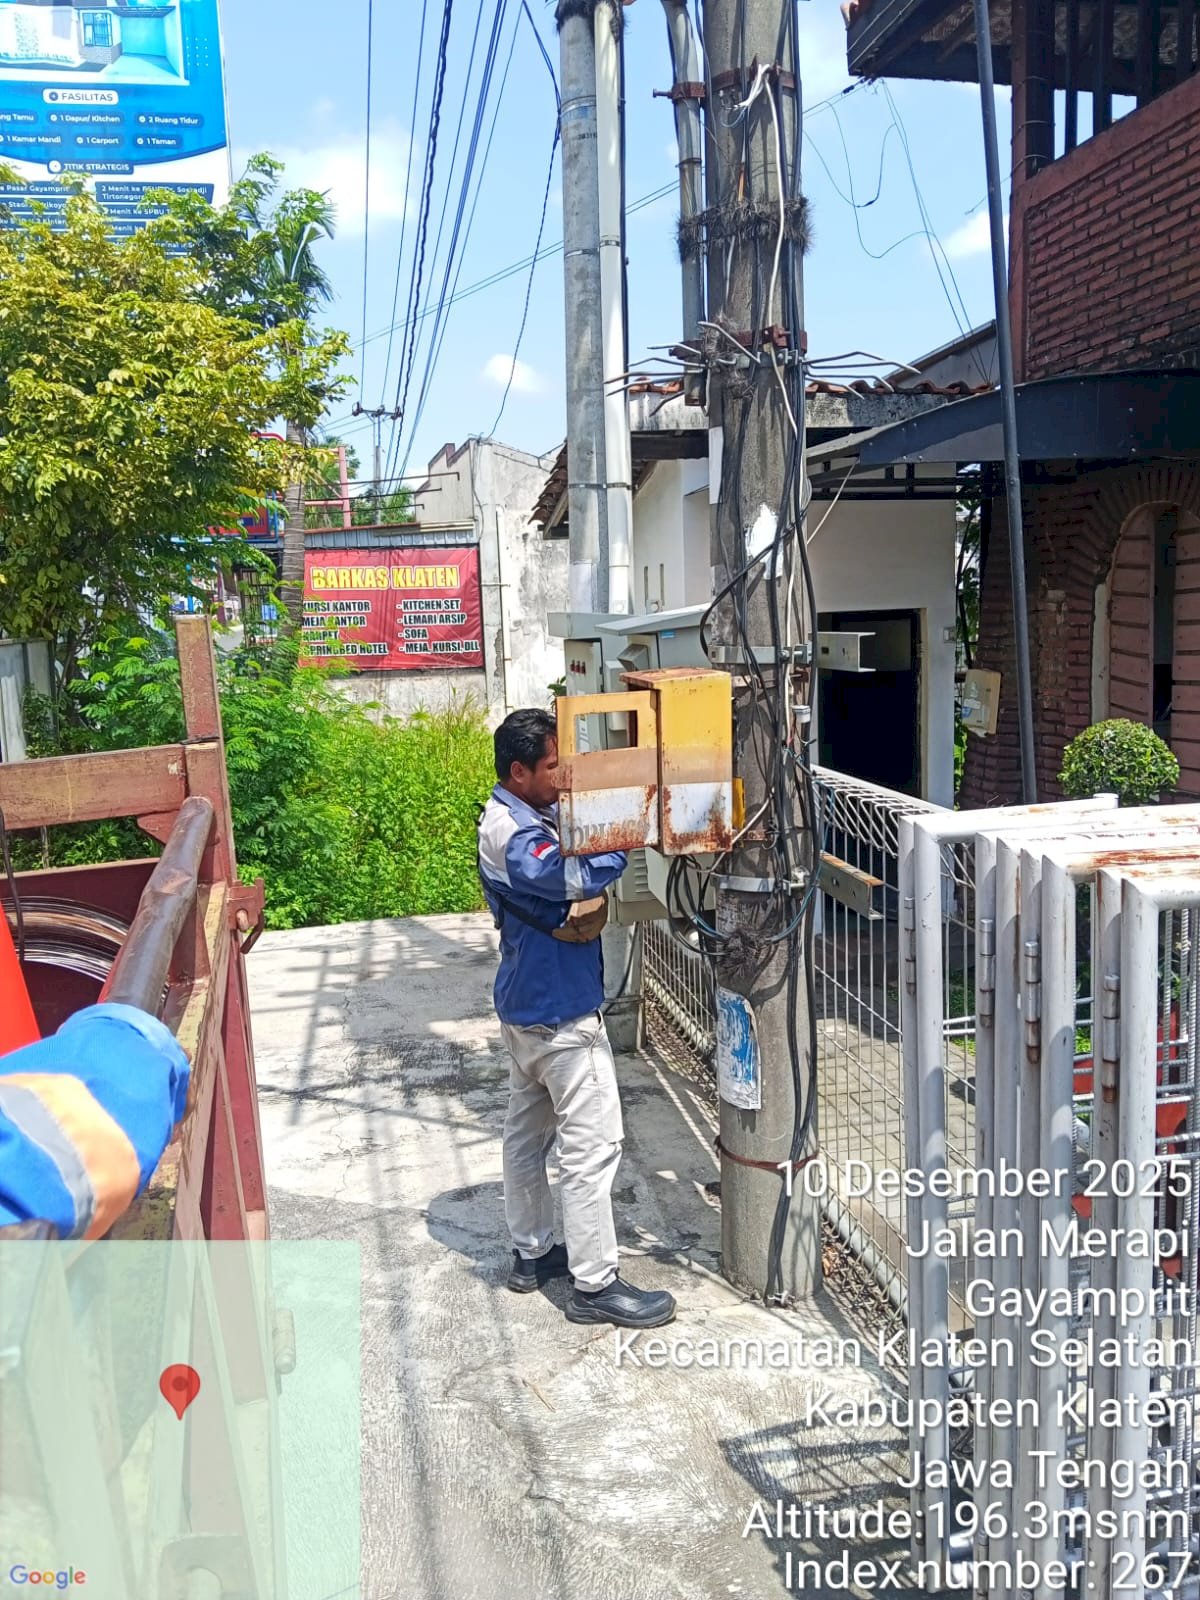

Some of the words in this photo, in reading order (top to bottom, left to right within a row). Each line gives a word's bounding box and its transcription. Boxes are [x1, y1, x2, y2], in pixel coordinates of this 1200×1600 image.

[61, 92, 114, 102] FASILITAS
[155, 116, 179, 125] Ruang
[180, 116, 198, 124] Tidur
[91, 137, 119, 145] Carport
[64, 163, 84, 171] TITIK
[86, 163, 130, 171] STRATEGIS
[310, 566, 390, 590] BARKAS
[391, 565, 460, 589] KLATEN
[332, 600, 371, 613] KANTOR
[402, 600, 442, 611] KITCHEN
[443, 599, 460, 610] SET
[328, 615, 367, 627] ANTOR
[403, 614, 437, 625] LEMARI
[439, 613, 467, 624] ARSIP
[404, 628, 428, 639] SOFA
[359, 643, 389, 655] HOTEL
[464, 640, 480, 651] DLL
